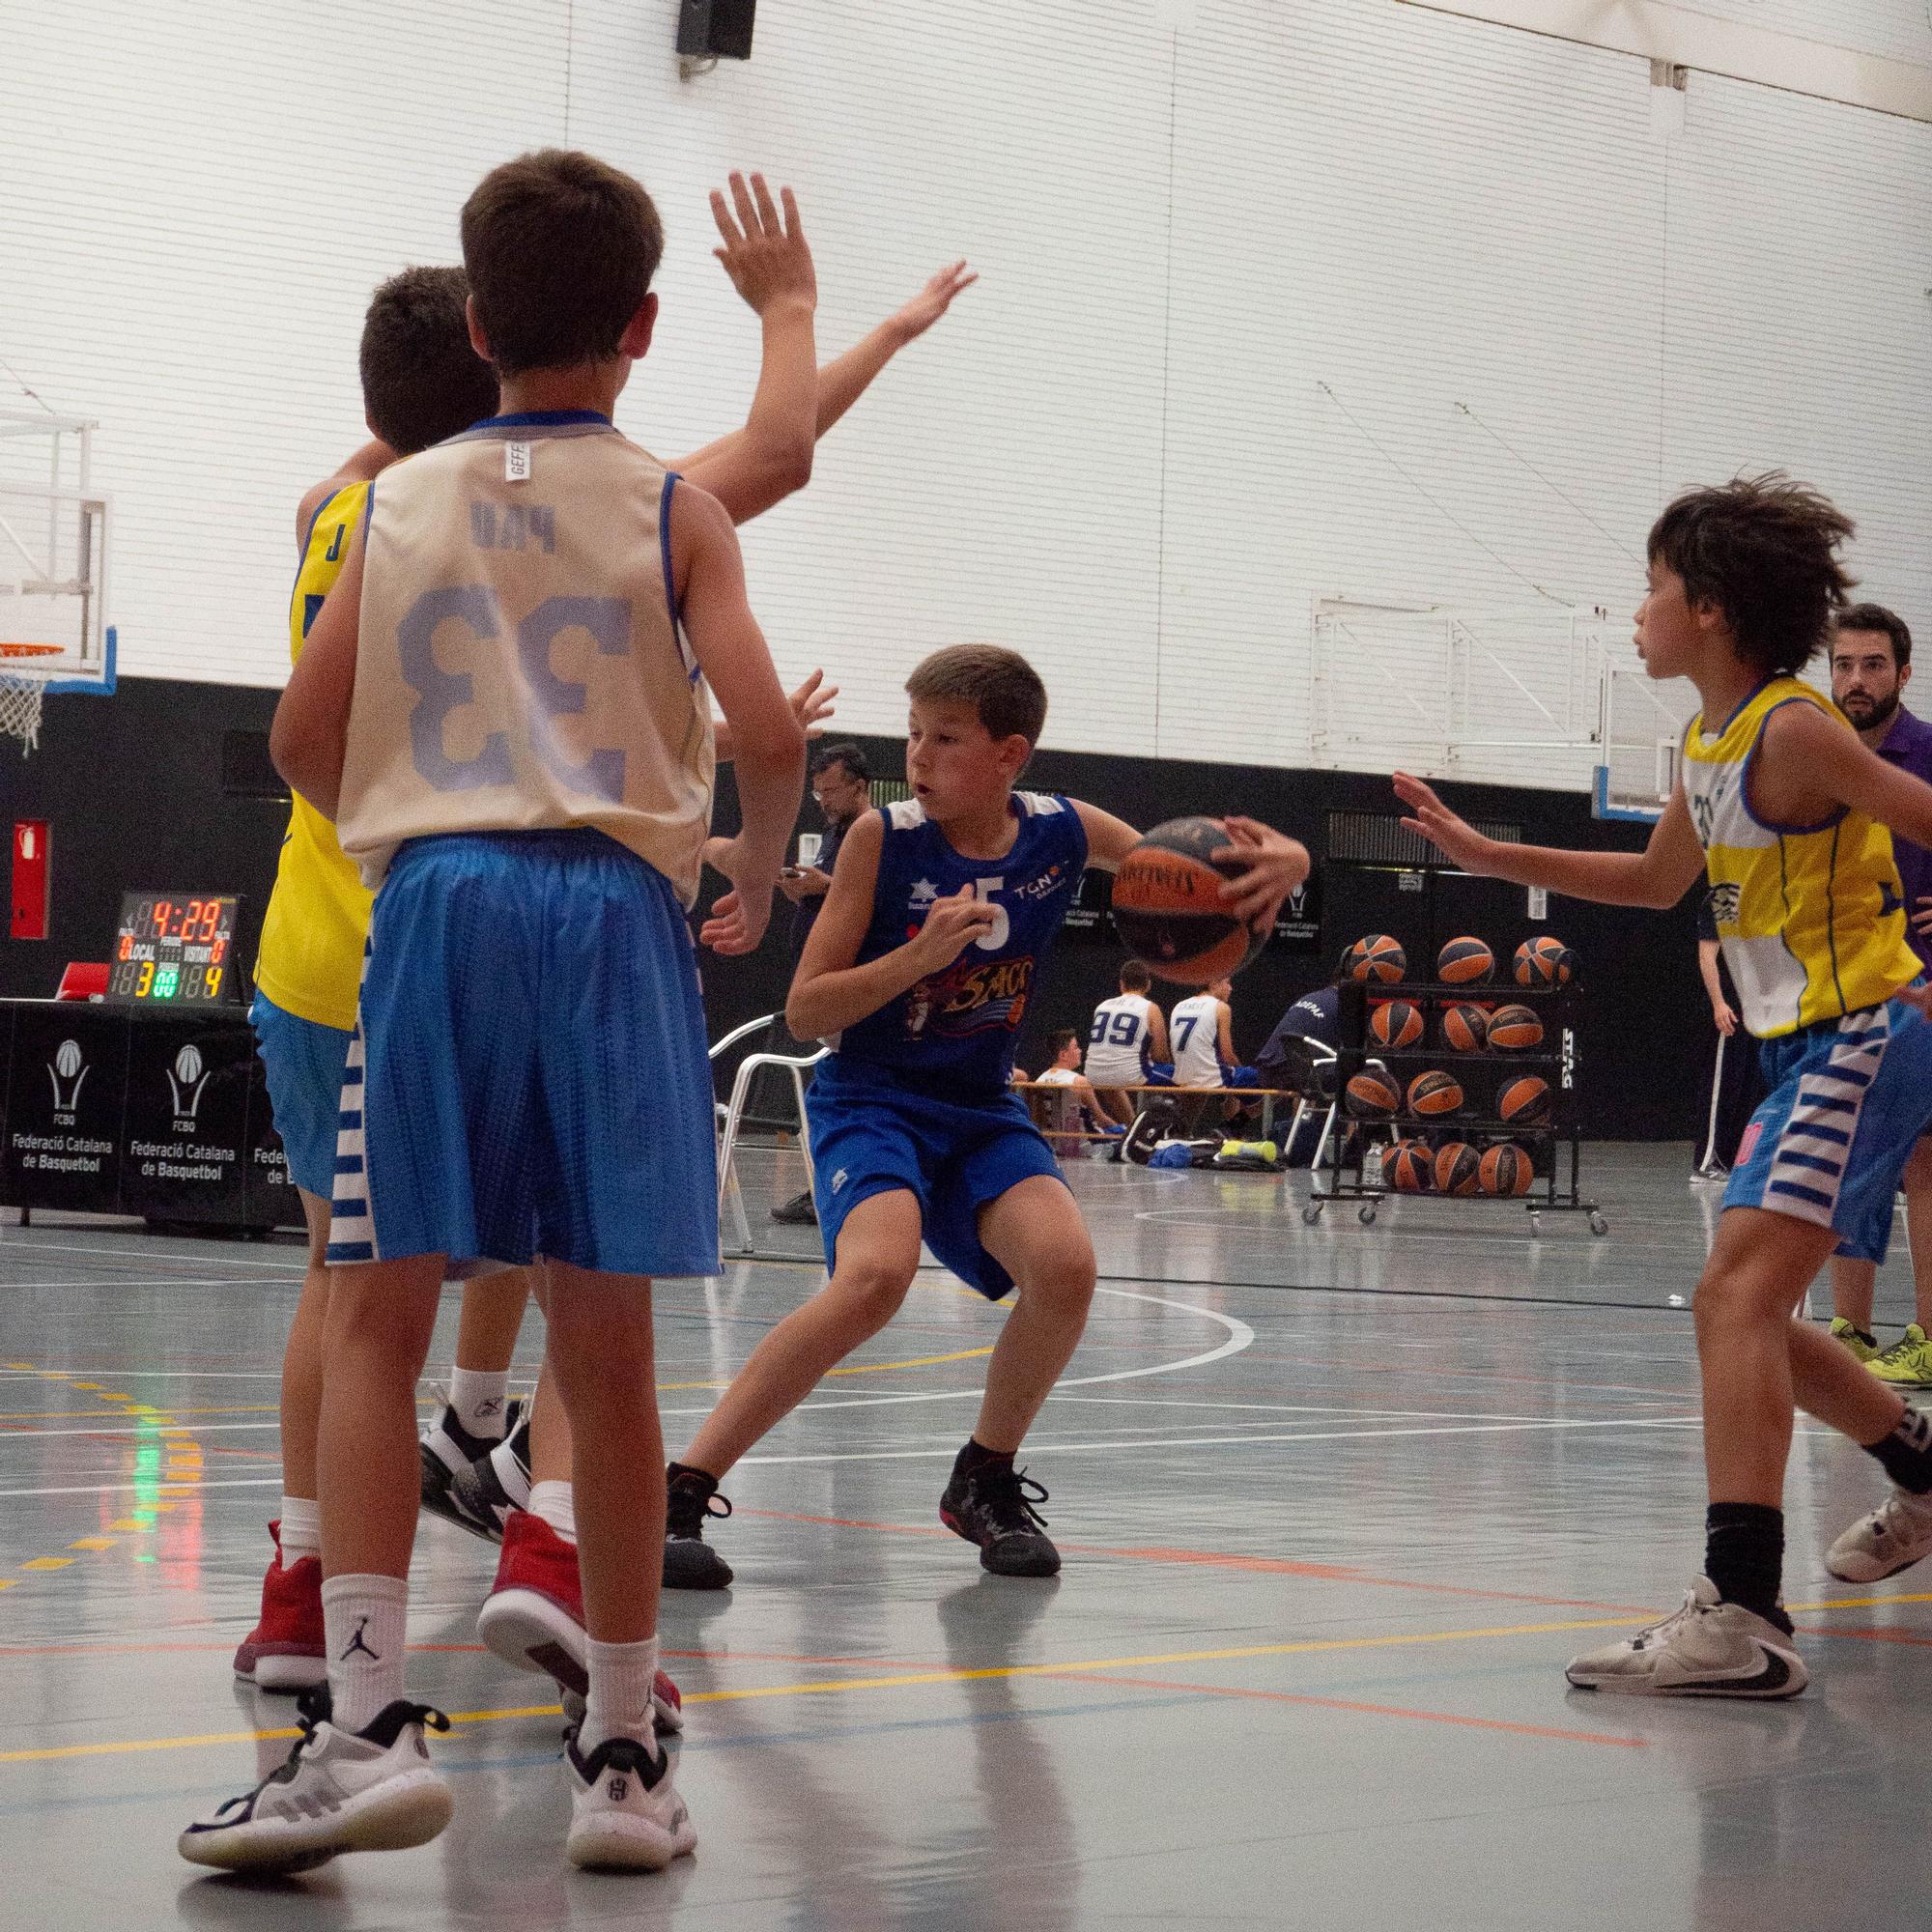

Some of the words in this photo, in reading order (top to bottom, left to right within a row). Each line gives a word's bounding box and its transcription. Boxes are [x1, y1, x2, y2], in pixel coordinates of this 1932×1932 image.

[154, 899, 221, 942] 4:29
[129, 943, 155, 961] LOCAL
[135, 961, 155, 997] 3
[205, 967, 223, 997] 4
[1089, 1011, 1140, 1046] 99
[1175, 1017, 1198, 1052] 7
[1561, 1028, 1575, 1090] STAG
[12, 1133, 64, 1151] Federació
[66, 1136, 113, 1153] Catalana
[130, 1141, 184, 1159] Federació
[185, 1144, 235, 1161] Catalana
[22, 1153, 37, 1169] de
[39, 1154, 99, 1173] Basquetbol
[141, 1161, 156, 1177] de
[158, 1162, 222, 1180] Basquetbol
[267, 1168, 283, 1184] de
